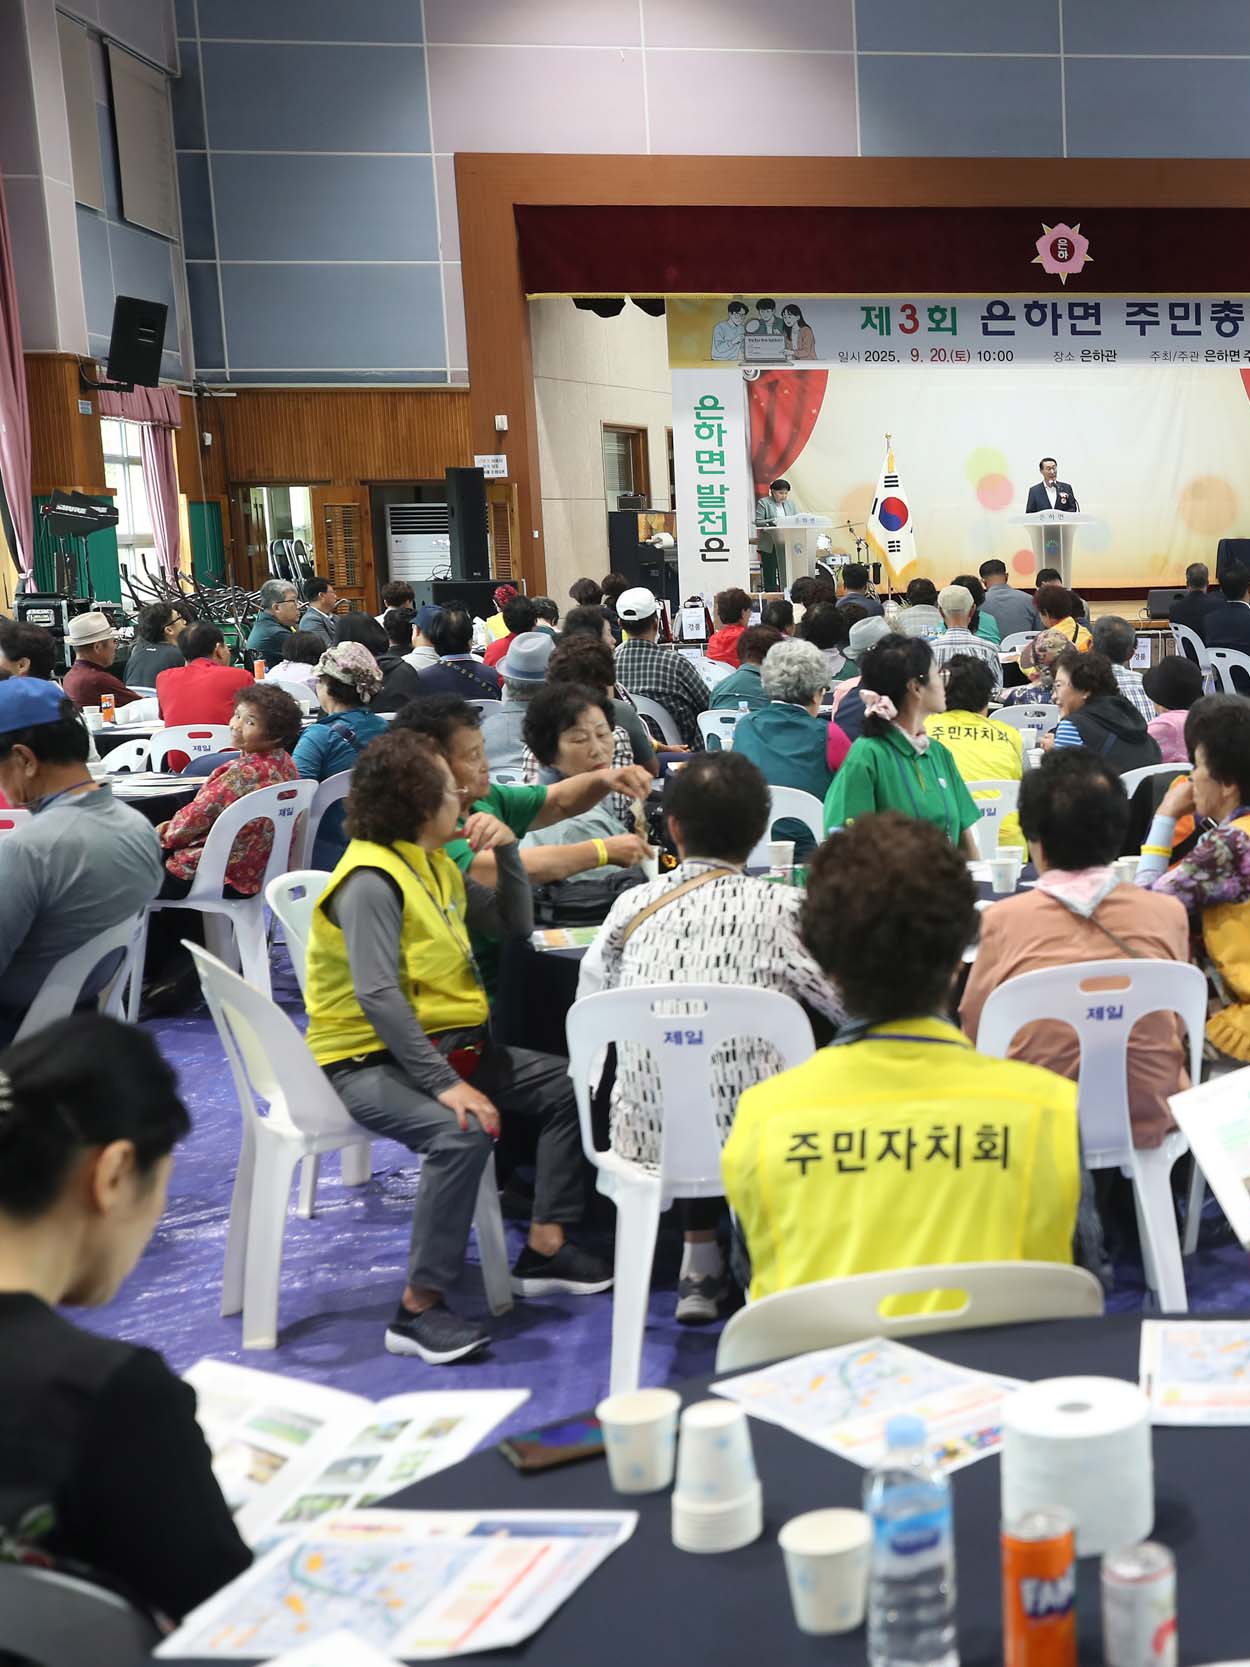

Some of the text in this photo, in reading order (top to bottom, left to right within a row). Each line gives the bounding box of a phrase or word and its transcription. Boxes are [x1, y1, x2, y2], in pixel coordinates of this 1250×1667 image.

[1057, 238, 1069, 260] 은하
[860, 303, 959, 336] 제3회
[980, 300, 1102, 337] 은하면
[838, 350, 861, 363] 일시
[864, 349, 901, 364] 2025.
[977, 350, 1014, 363] 10:00
[1053, 349, 1118, 363] 장소 은하관
[1151, 350, 1200, 363] 주최/주관
[1204, 349, 1241, 363] 은하면
[694, 395, 730, 563] 은하면 발전은
[931, 726, 1009, 743] 주민자치회
[278, 807, 295, 817] 제일
[1085, 1004, 1124, 1020] 제일
[663, 1029, 704, 1046] 제일
[784, 1124, 1010, 1177] 주민자치회
